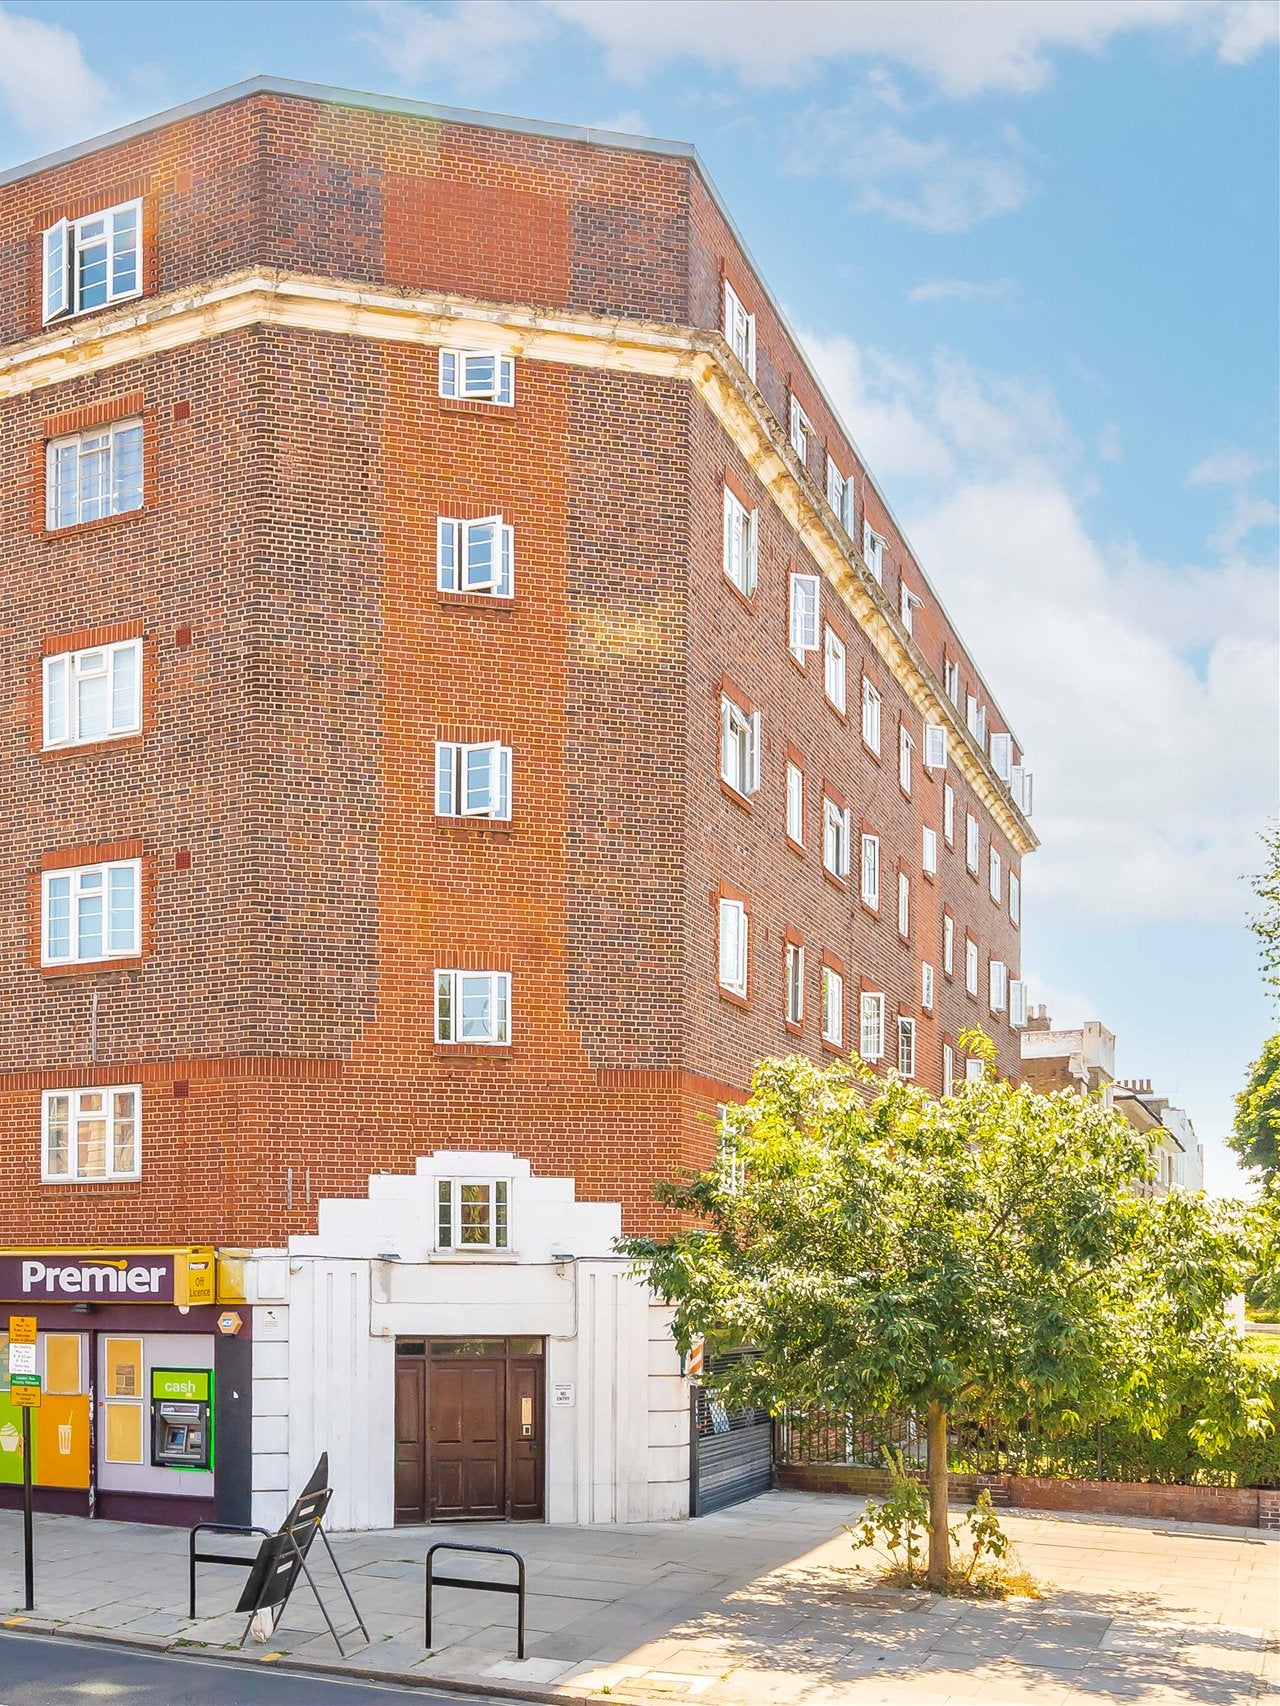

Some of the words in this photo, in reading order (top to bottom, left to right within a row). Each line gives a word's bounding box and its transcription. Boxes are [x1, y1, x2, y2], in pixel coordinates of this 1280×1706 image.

[190, 1262, 206, 1270] Premier
[22, 1260, 167, 1293] Premier
[195, 1277, 204, 1286] Off
[190, 1288, 210, 1297] Licence
[164, 1380, 196, 1392] cash
